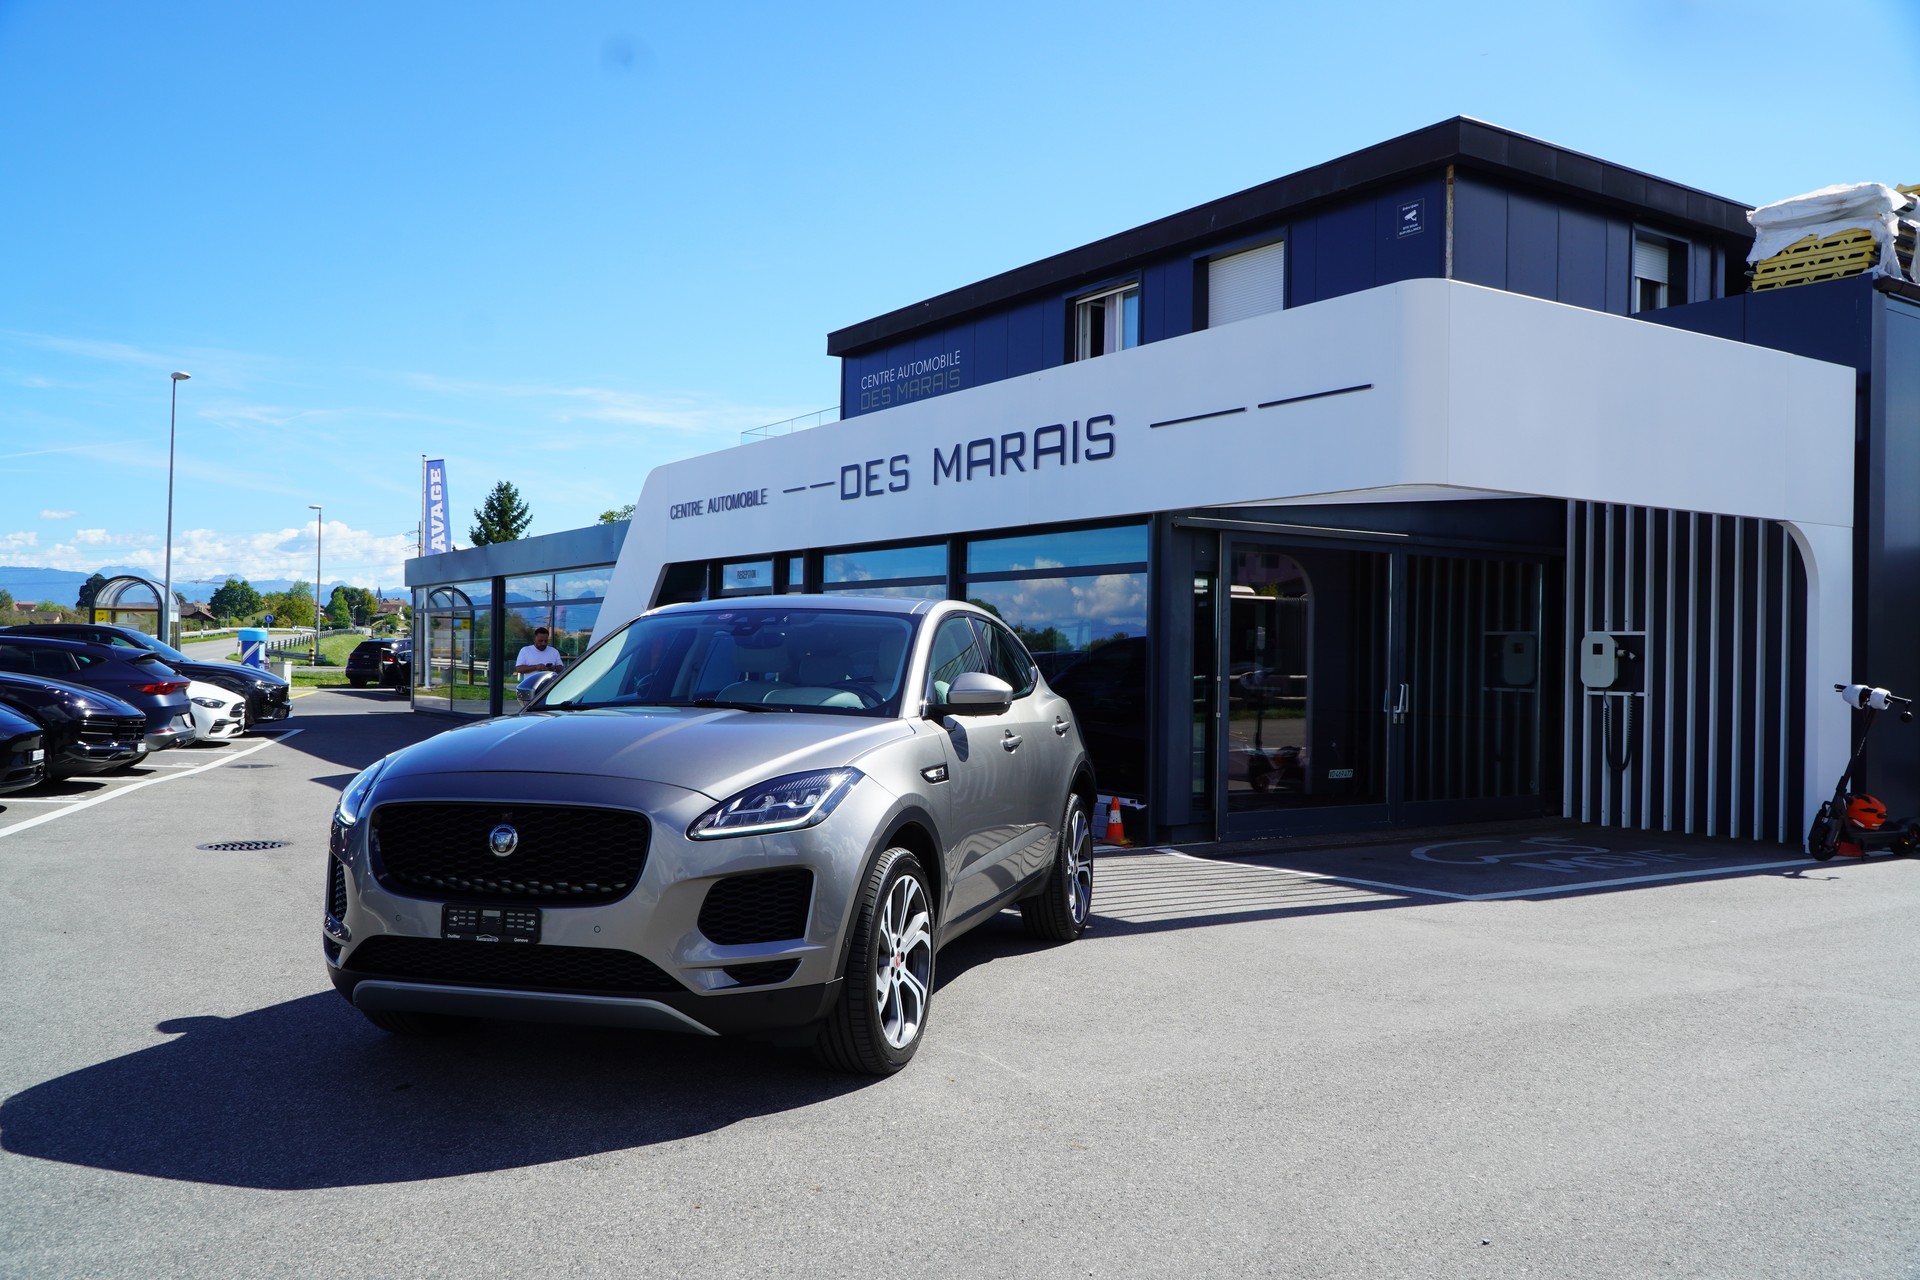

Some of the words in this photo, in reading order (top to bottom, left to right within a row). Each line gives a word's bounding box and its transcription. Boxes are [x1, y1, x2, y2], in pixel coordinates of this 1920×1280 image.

[861, 368, 895, 390] CENTRE
[897, 350, 961, 380] AUTOMOBILE
[861, 386, 891, 411] DES
[897, 368, 961, 401] MARAIS
[670, 500, 703, 520] CENTRE
[707, 488, 768, 514] AUTOMOBILE
[840, 454, 910, 501] DES
[933, 414, 1115, 486] MARAIS
[1510, 848, 1718, 874] MOVE
